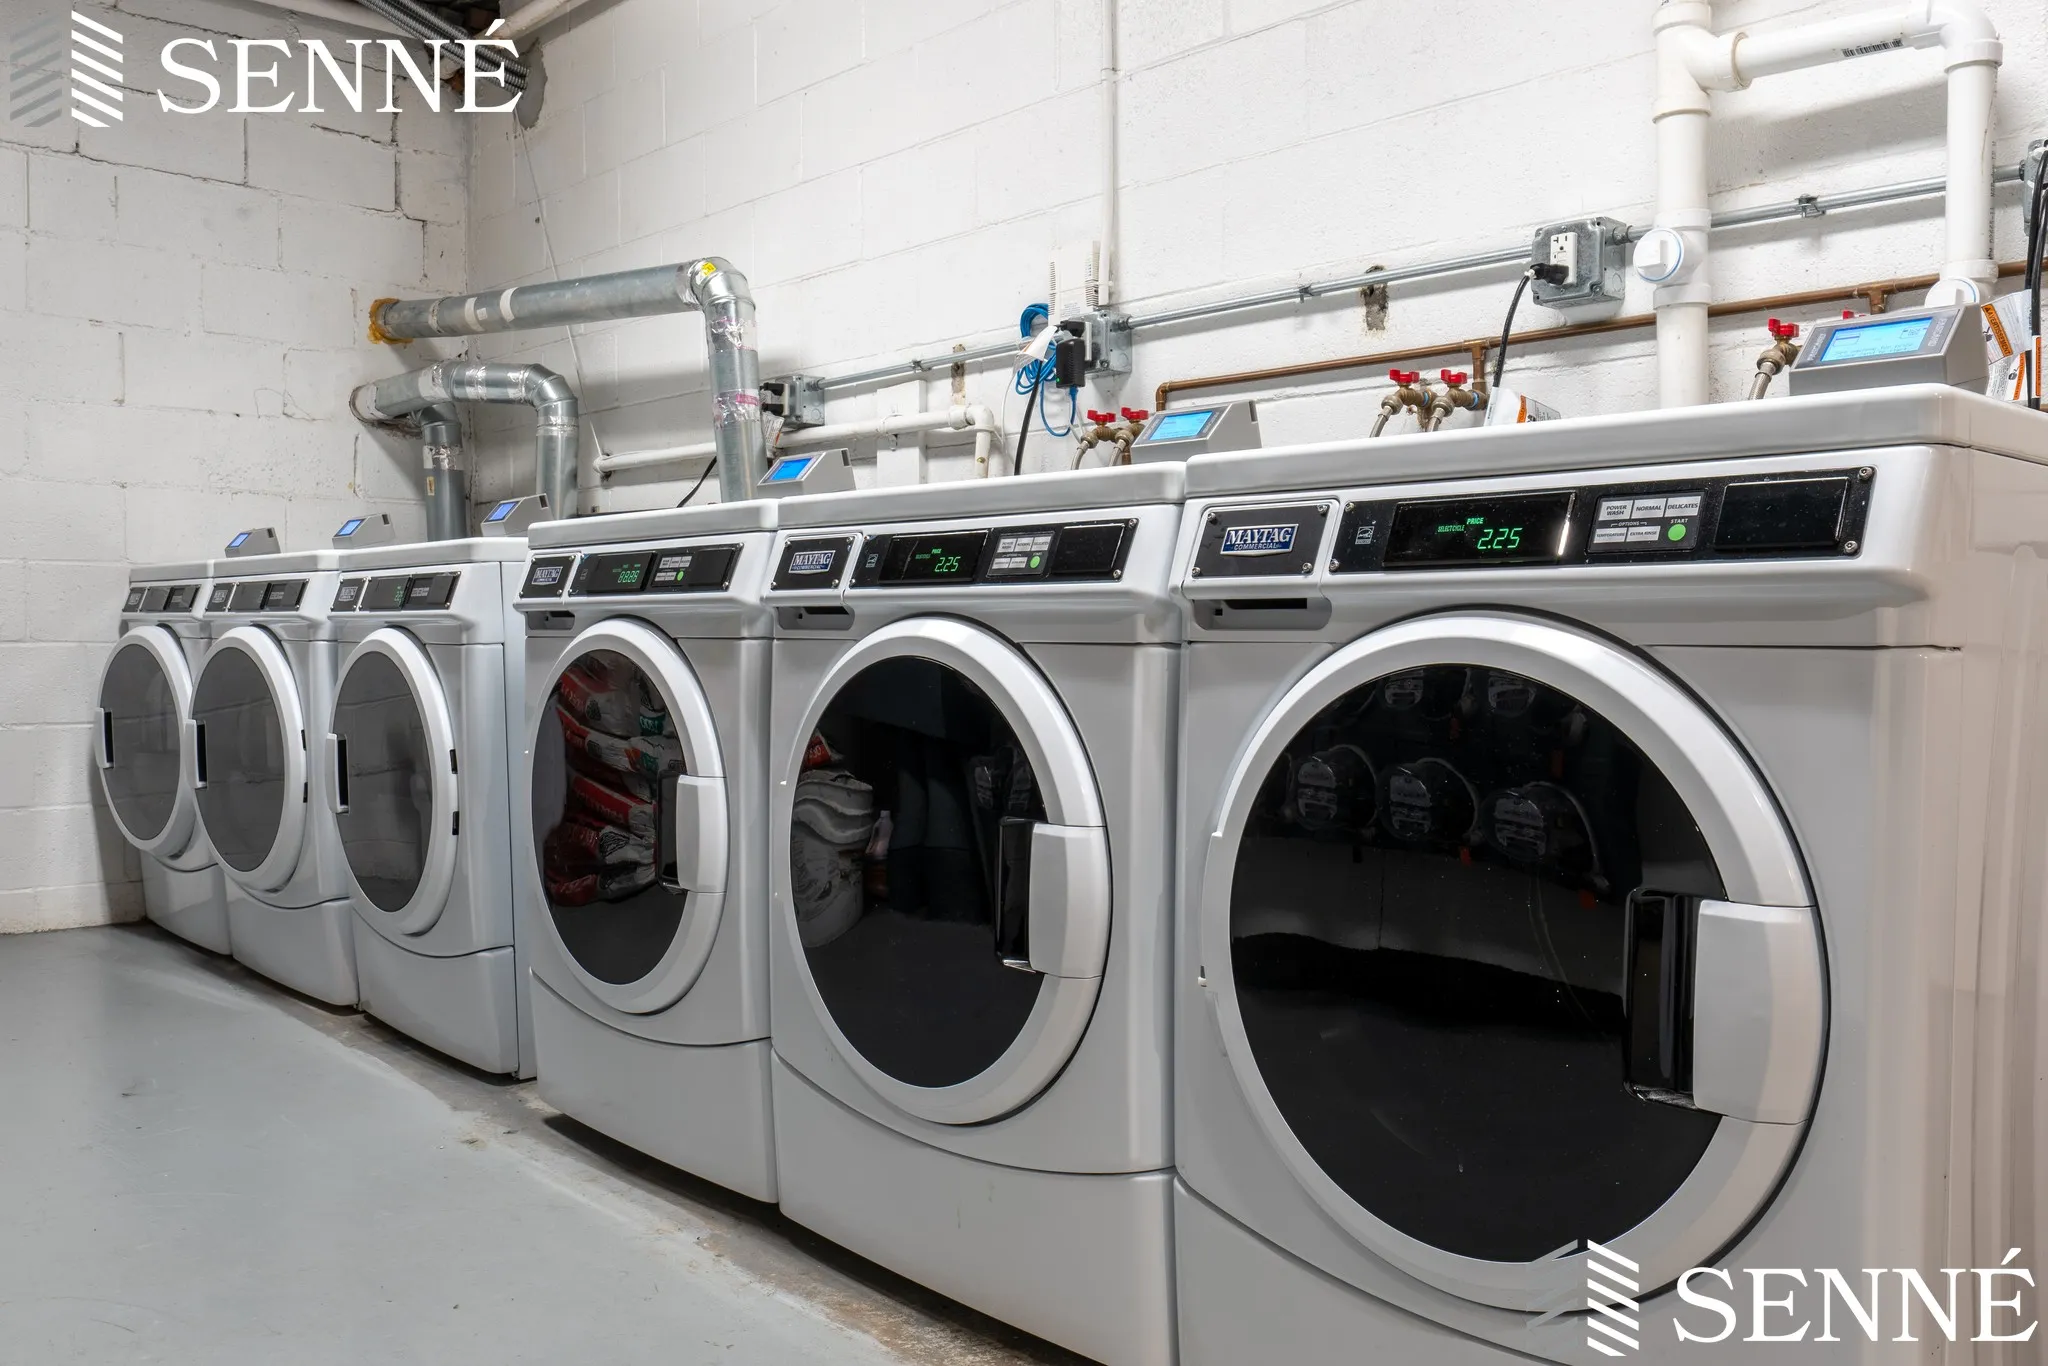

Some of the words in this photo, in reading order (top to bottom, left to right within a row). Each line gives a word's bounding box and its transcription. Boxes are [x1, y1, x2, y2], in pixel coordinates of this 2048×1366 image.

[1226, 528, 1291, 545] MAYTAG
[1477, 527, 1523, 549] 2.25
[1234, 543, 1277, 551] COMMERCIAL
[794, 552, 831, 566] MAYTAG
[934, 556, 961, 572] 2.25
